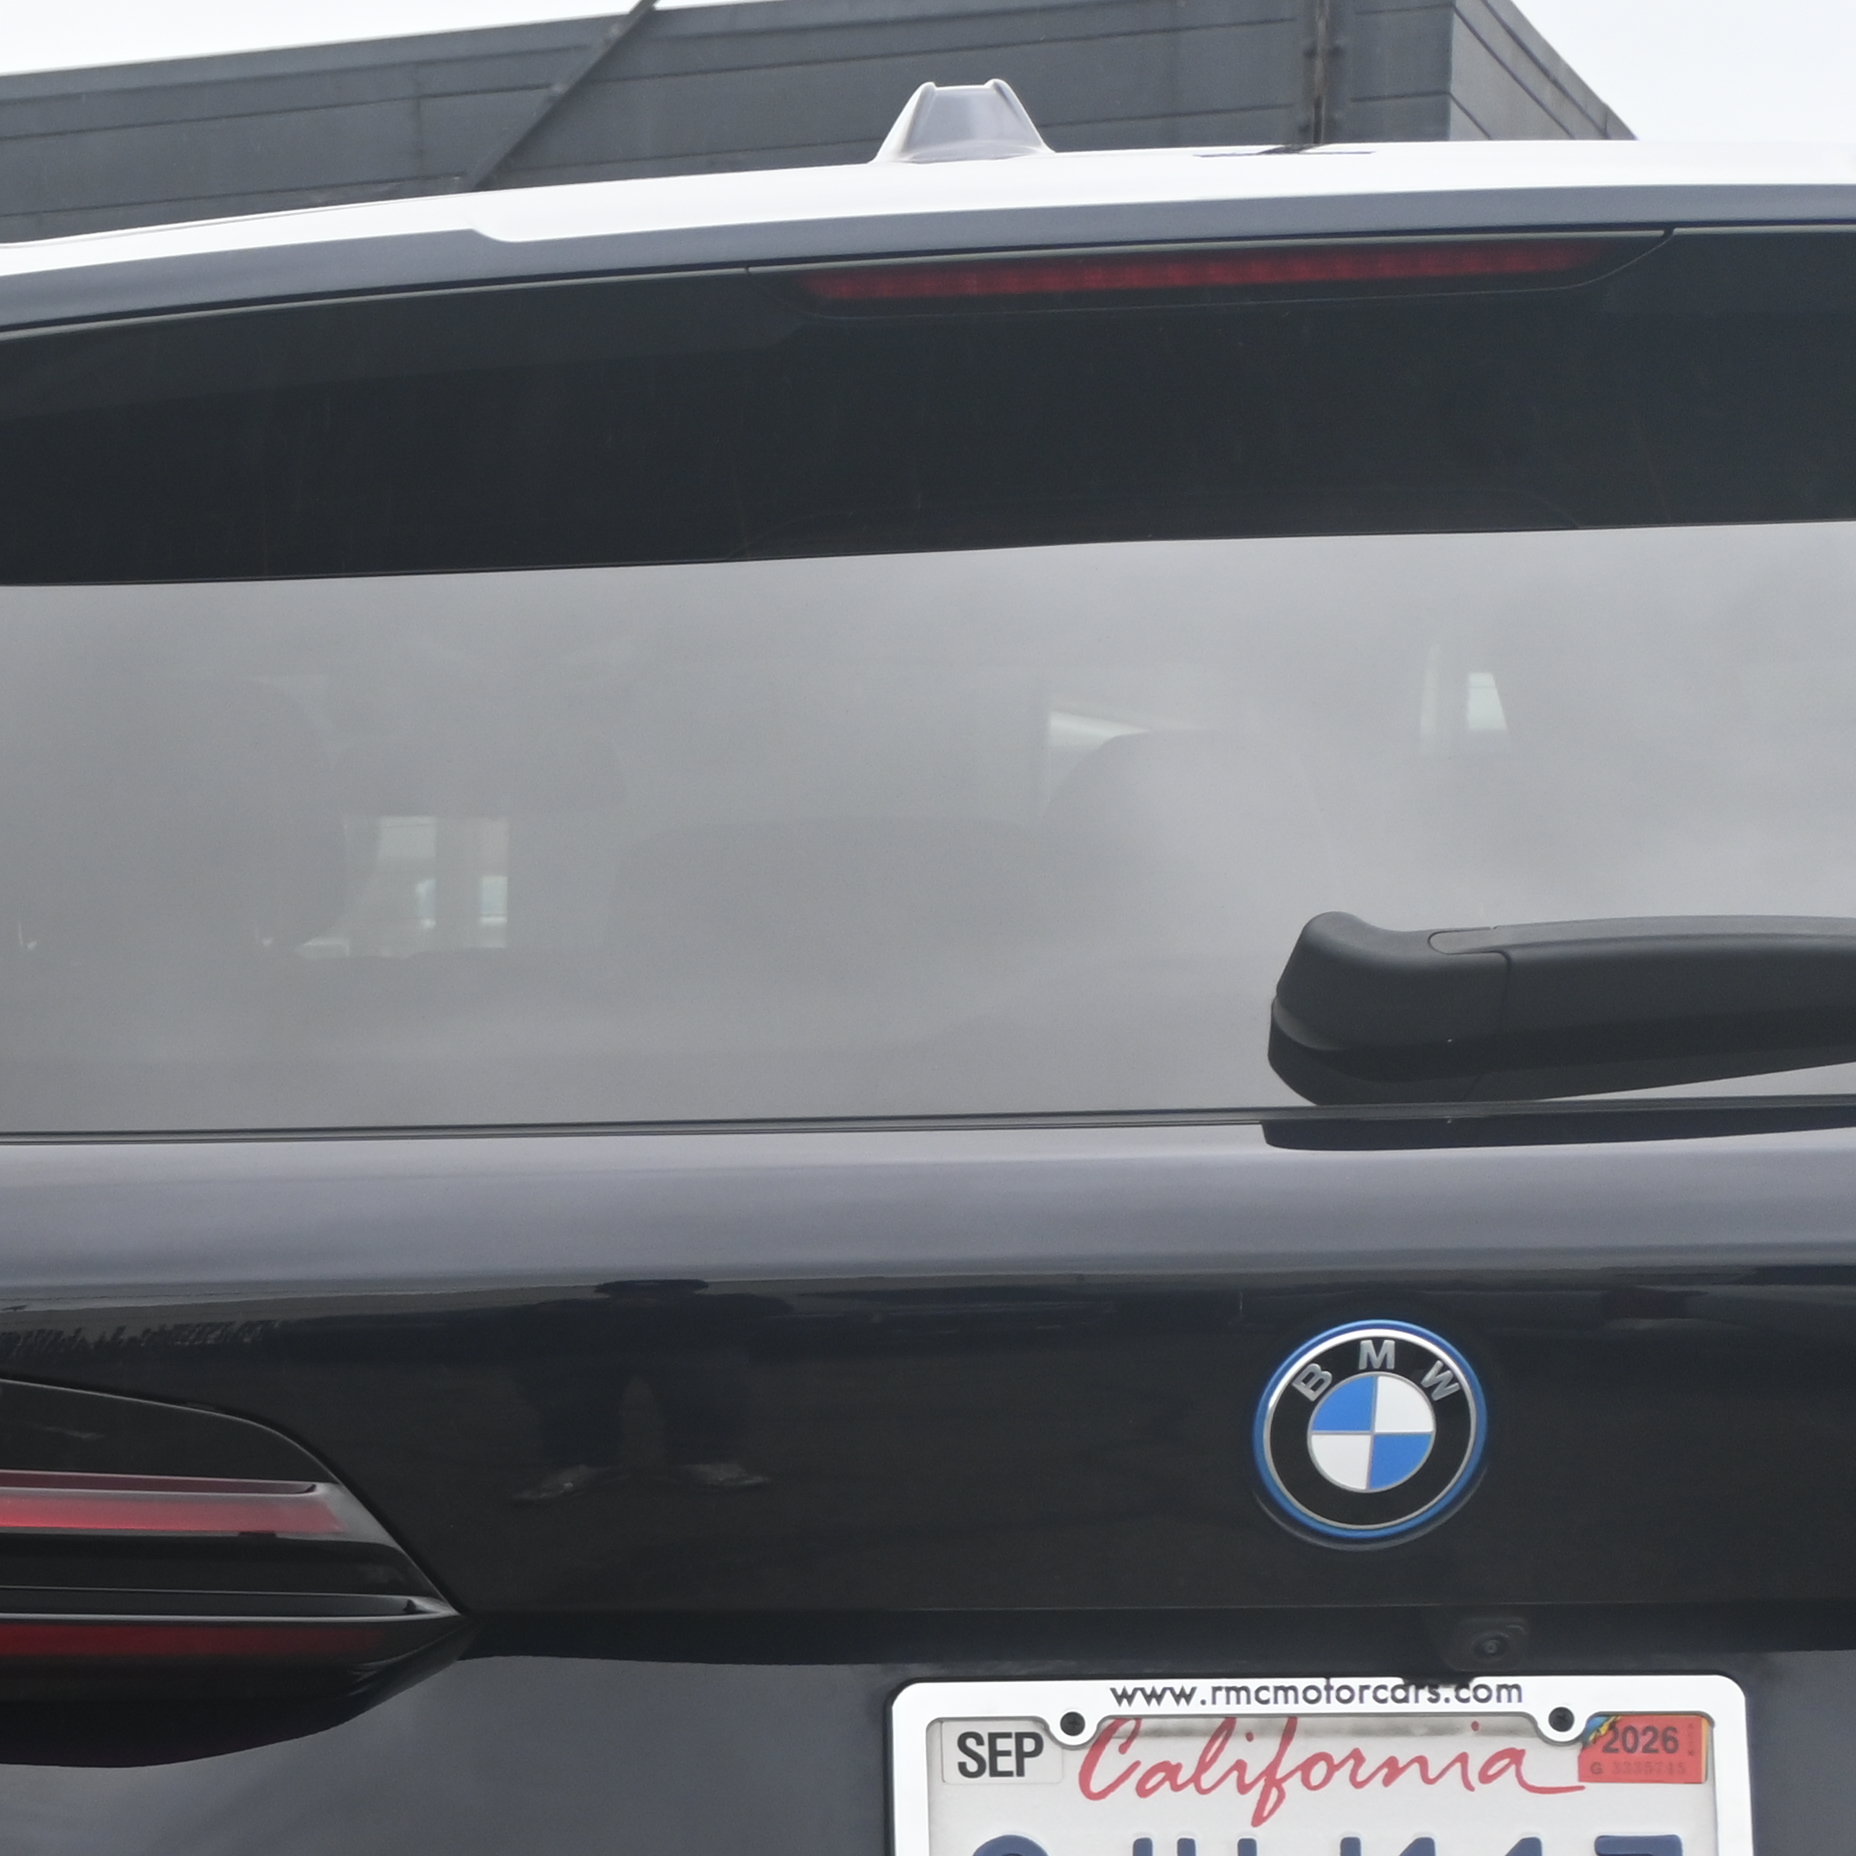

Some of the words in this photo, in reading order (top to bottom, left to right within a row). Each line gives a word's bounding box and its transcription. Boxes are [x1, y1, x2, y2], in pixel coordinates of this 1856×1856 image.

[1290, 1339, 1461, 1402] BMW
[1109, 1677, 1524, 1706] www.rmcmotorcars.com
[956, 1731, 1045, 1779] SEP
[1602, 1725, 1680, 1754] 2026
[1077, 1716, 1586, 1827] California
